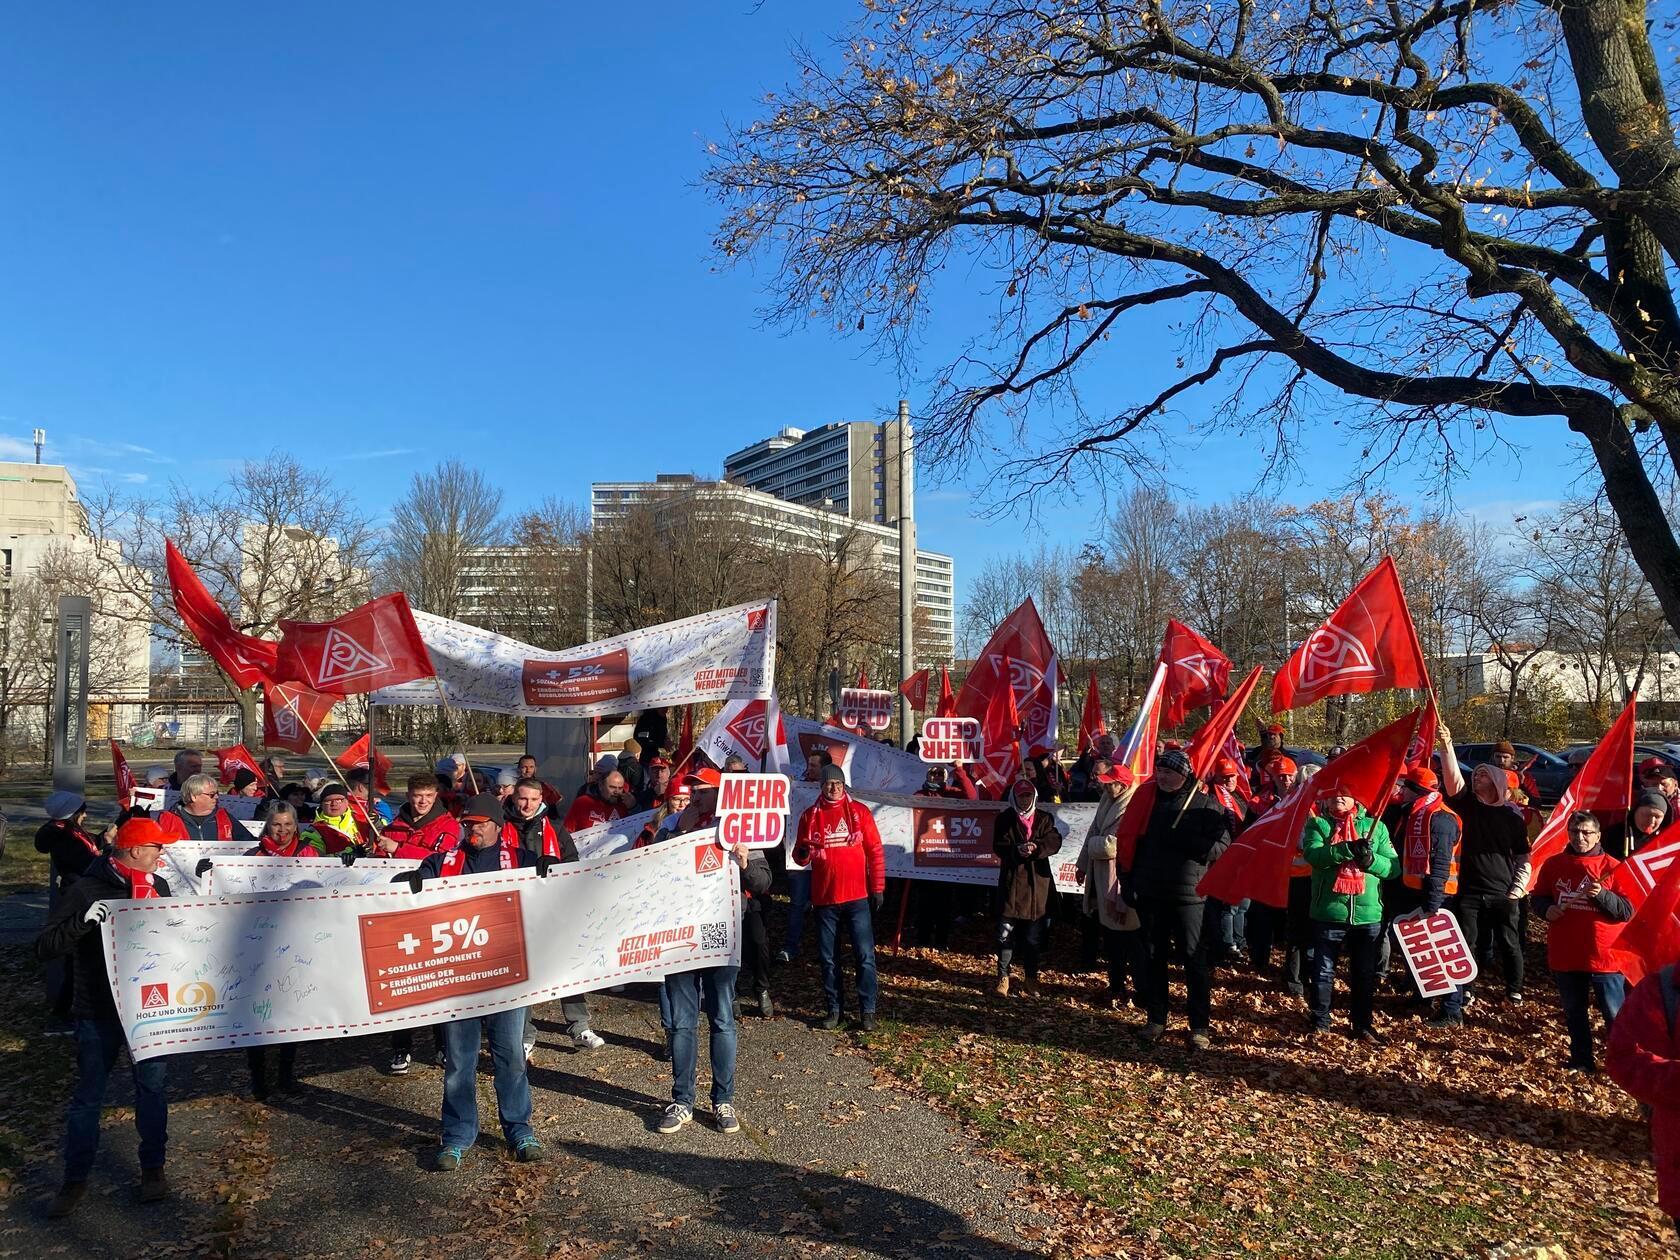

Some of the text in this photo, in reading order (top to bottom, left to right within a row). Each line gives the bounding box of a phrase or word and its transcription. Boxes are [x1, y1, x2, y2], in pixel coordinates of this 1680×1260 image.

[568, 664, 605, 679] 5%
[694, 668, 748, 680] JETZT MITGLIED
[695, 679, 726, 690] WERDEN
[842, 691, 892, 709] MEHR
[844, 709, 888, 727] GELD
[925, 721, 977, 739] GELD
[923, 741, 981, 759] MEHR
[721, 779, 786, 810] MEHR
[723, 812, 782, 844] GELD
[932, 817, 982, 837] + 5%
[1059, 863, 1078, 872] JETZ
[1059, 872, 1077, 882] WER
[397, 915, 489, 955] + 5%
[617, 925, 695, 953] JETZT MITGLIED
[1398, 912, 1450, 993] MEHR
[1426, 912, 1472, 980] GELD
[387, 951, 482, 975] SOZIALE KOMPONENTE
[619, 946, 661, 968] WERDEN
[389, 969, 454, 989] ERHÖHUNG DER
[391, 966, 509, 997] AUSBILDUNGSVERGÜTUNGEN
[136, 1011, 156, 1020] HOLZ
[177, 1003, 225, 1014] KUNSTSTOFF
